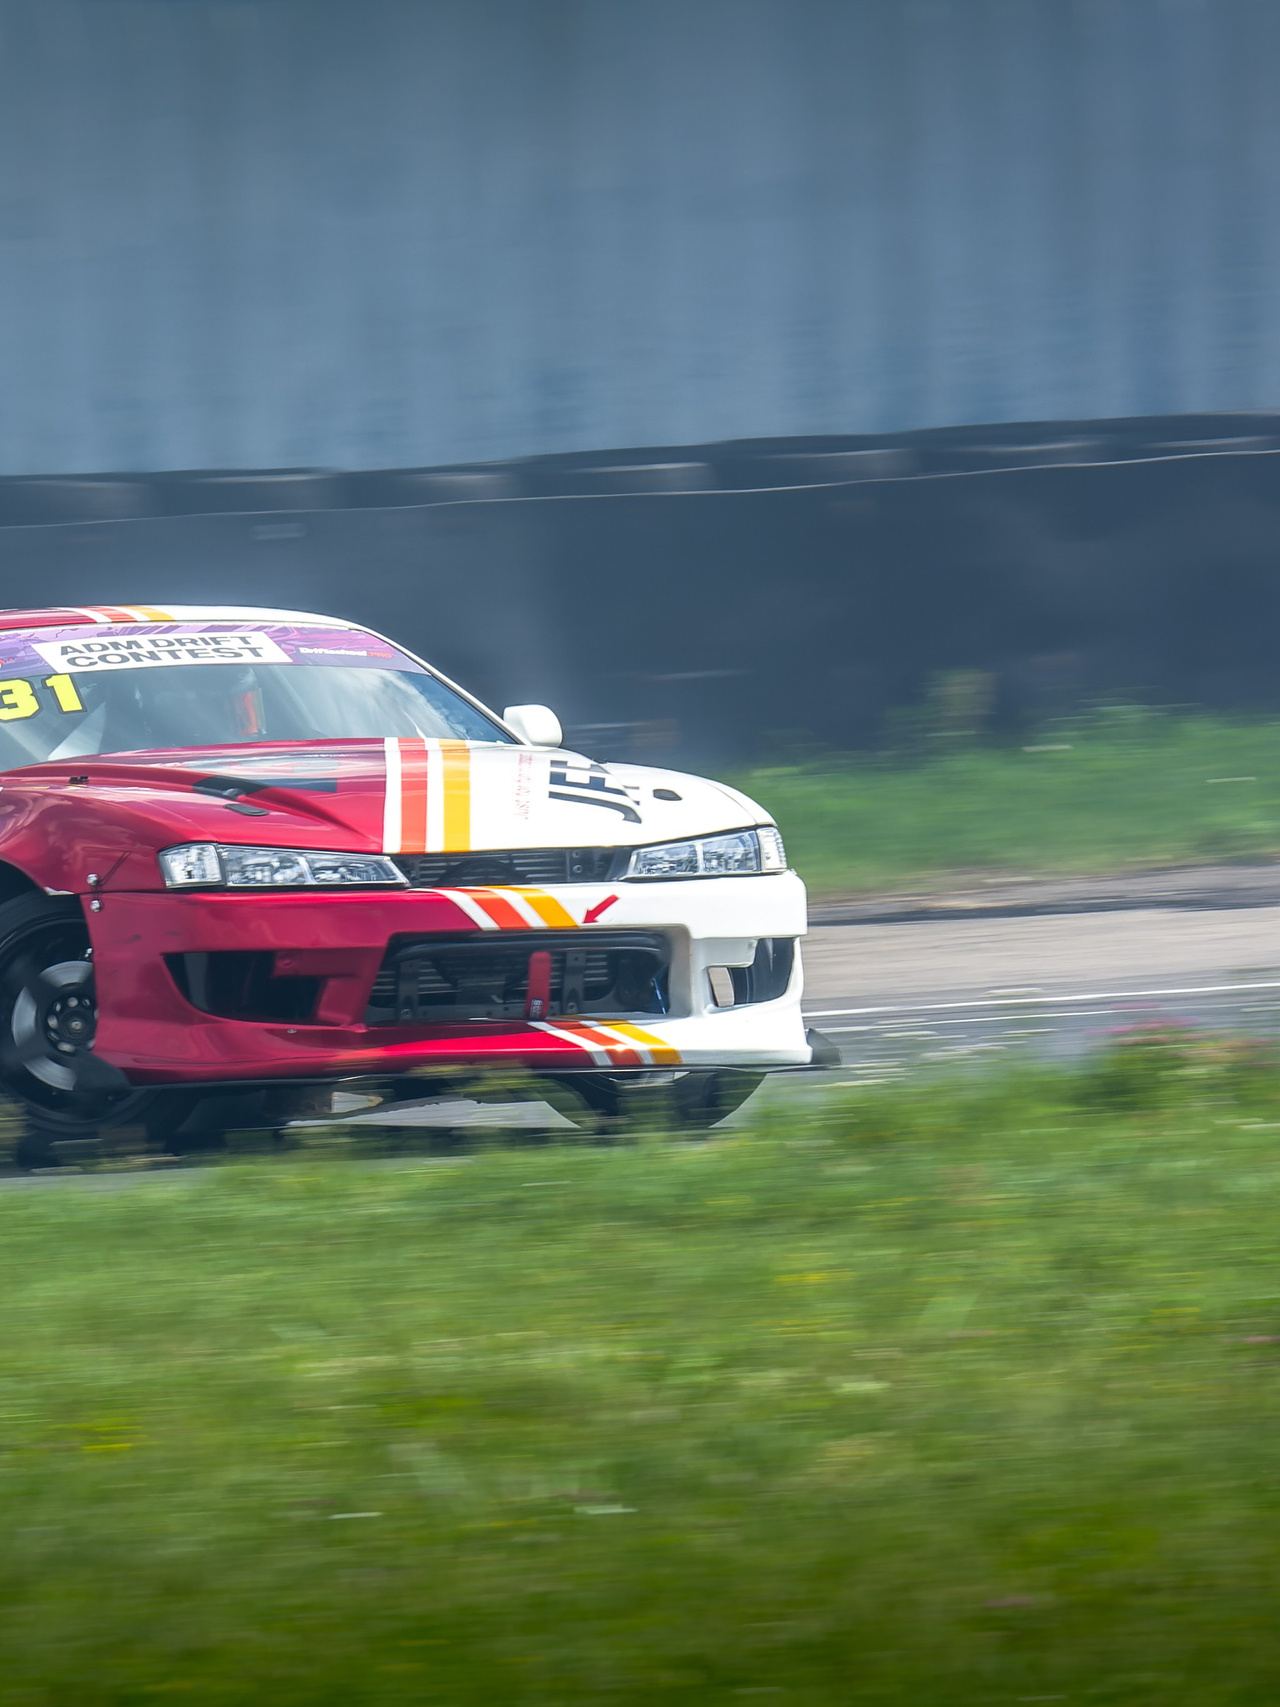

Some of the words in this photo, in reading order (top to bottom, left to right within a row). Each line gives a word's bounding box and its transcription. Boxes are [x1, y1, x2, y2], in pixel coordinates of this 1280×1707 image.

[60, 639, 144, 656] ADM
[147, 635, 253, 649] DRIFT
[66, 646, 264, 668] CONTEST
